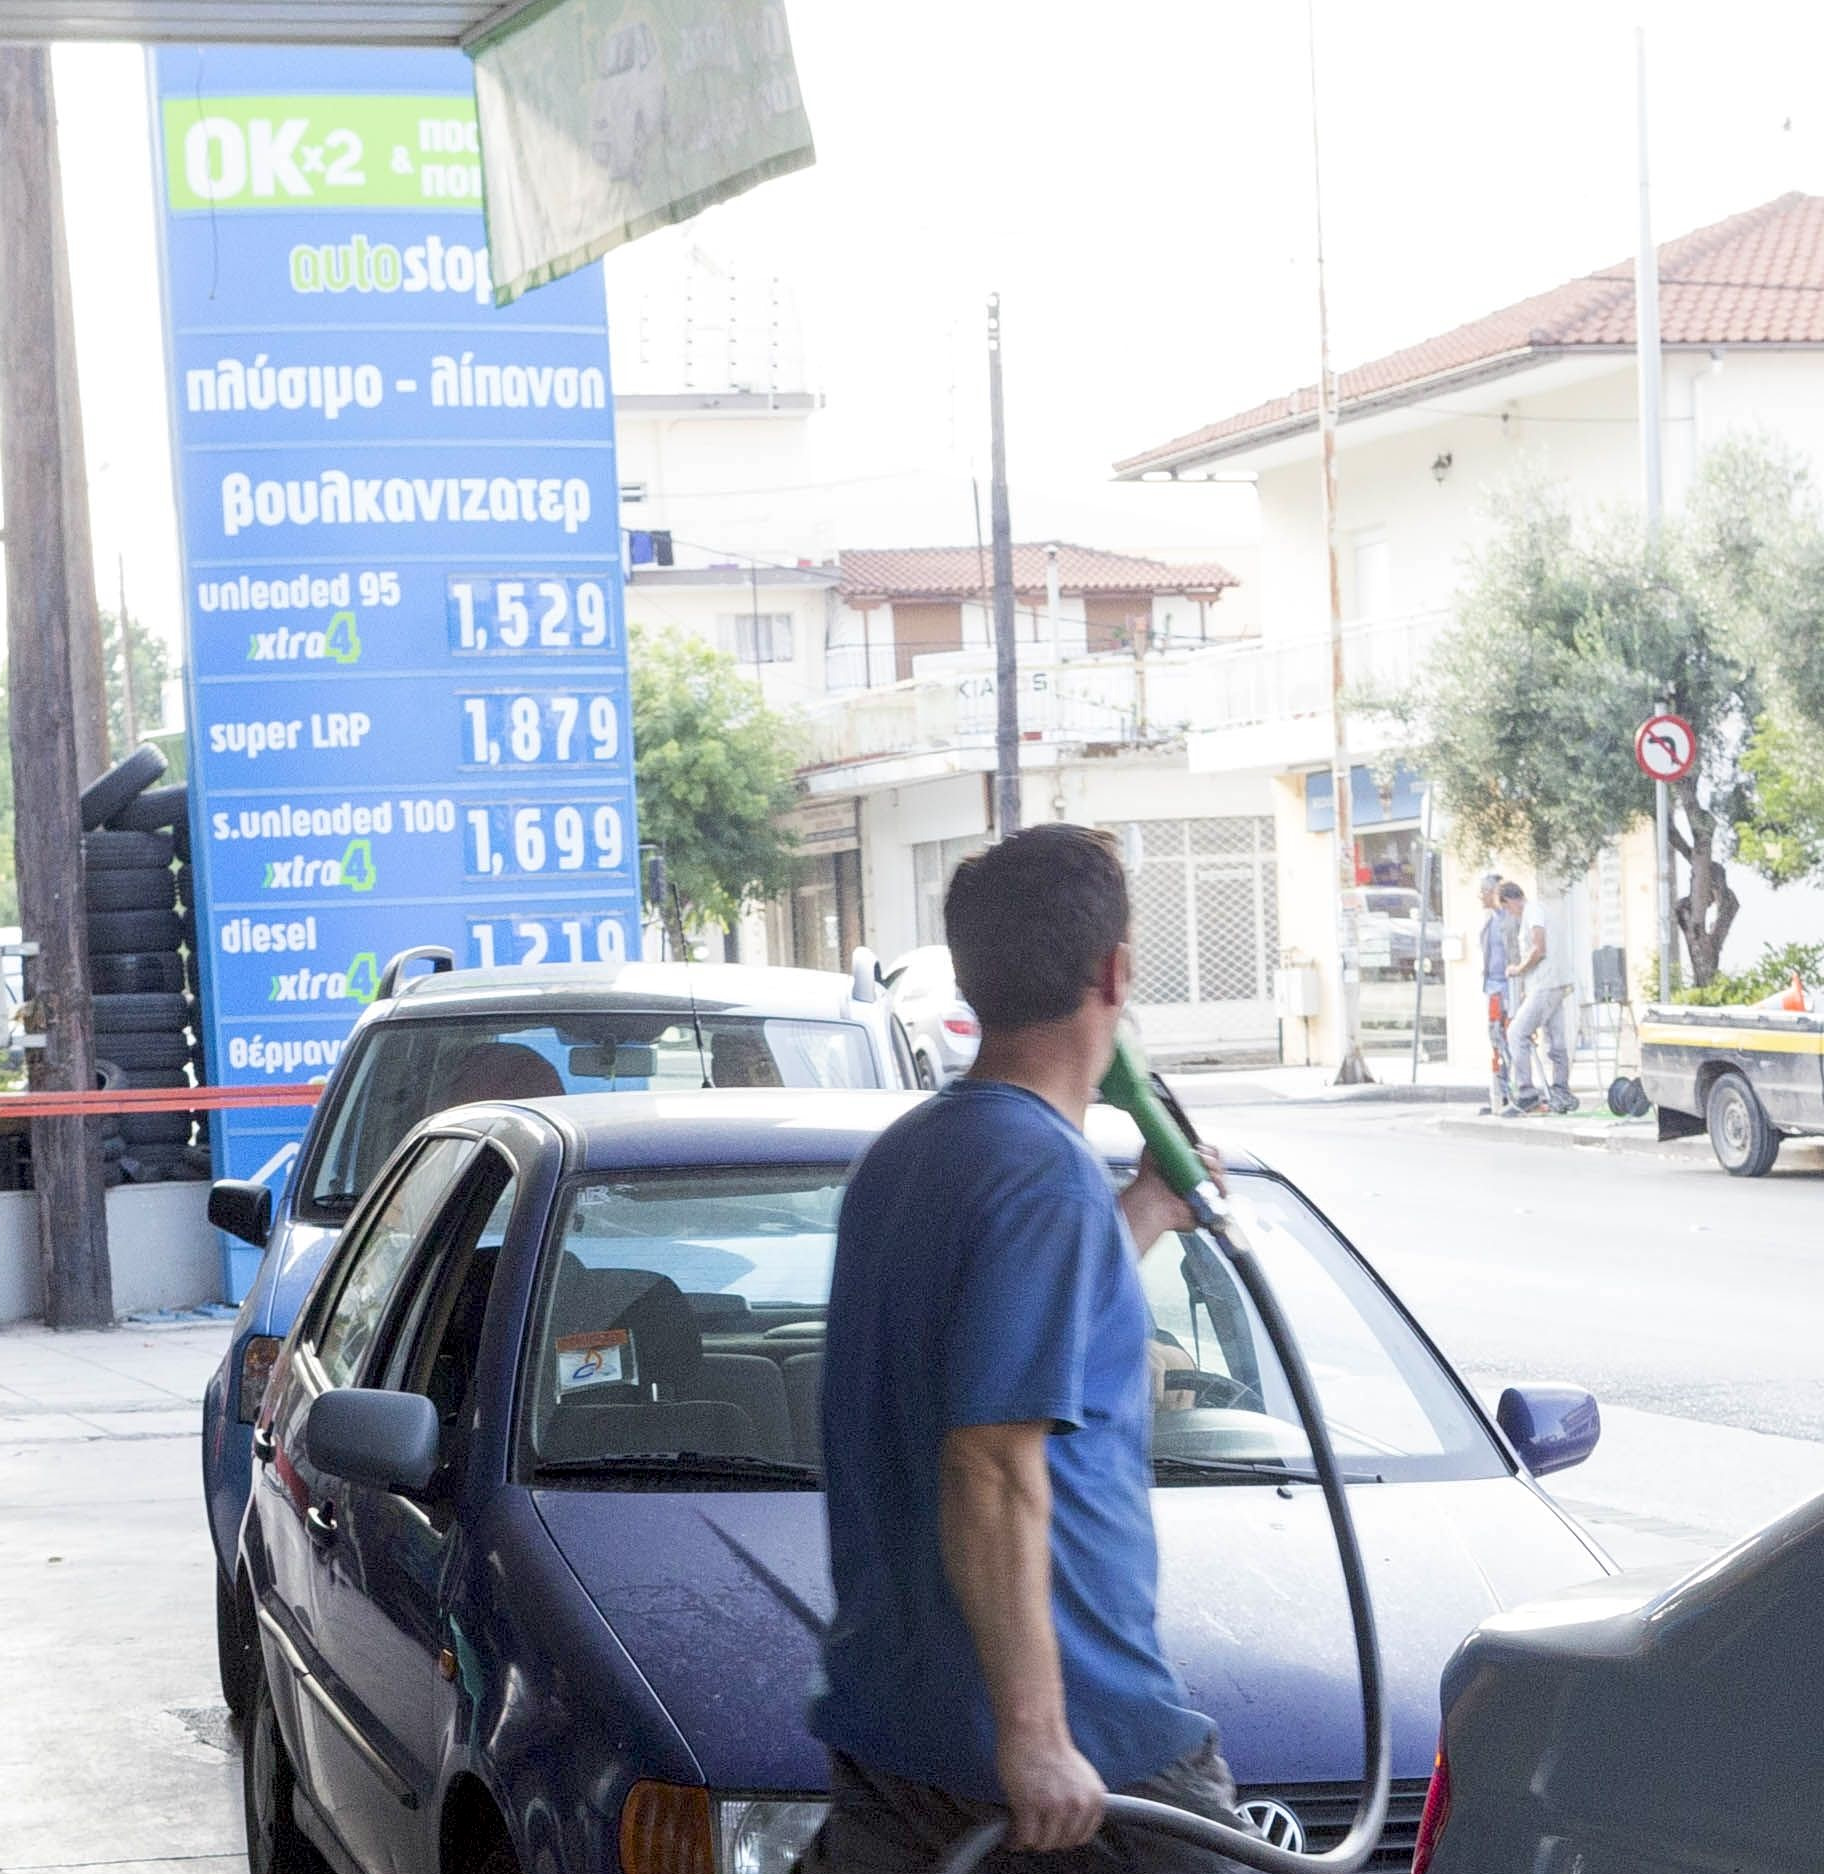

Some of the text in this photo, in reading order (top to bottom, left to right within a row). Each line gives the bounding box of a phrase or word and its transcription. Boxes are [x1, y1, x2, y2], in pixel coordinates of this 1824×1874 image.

[186, 354, 384, 419] πλύσιμο
[430, 352, 606, 411] λίπανση
[221, 470, 591, 536] βουλκανιζατερ
[198, 571, 401, 612] unleaded 95
[451, 581, 607, 651] 1,529
[210, 712, 371, 759] super LRP
[463, 696, 619, 766] 1,879
[212, 799, 456, 841] s.unleaded 100
[466, 805, 624, 877] 1,699
[220, 916, 317, 954] diesel
